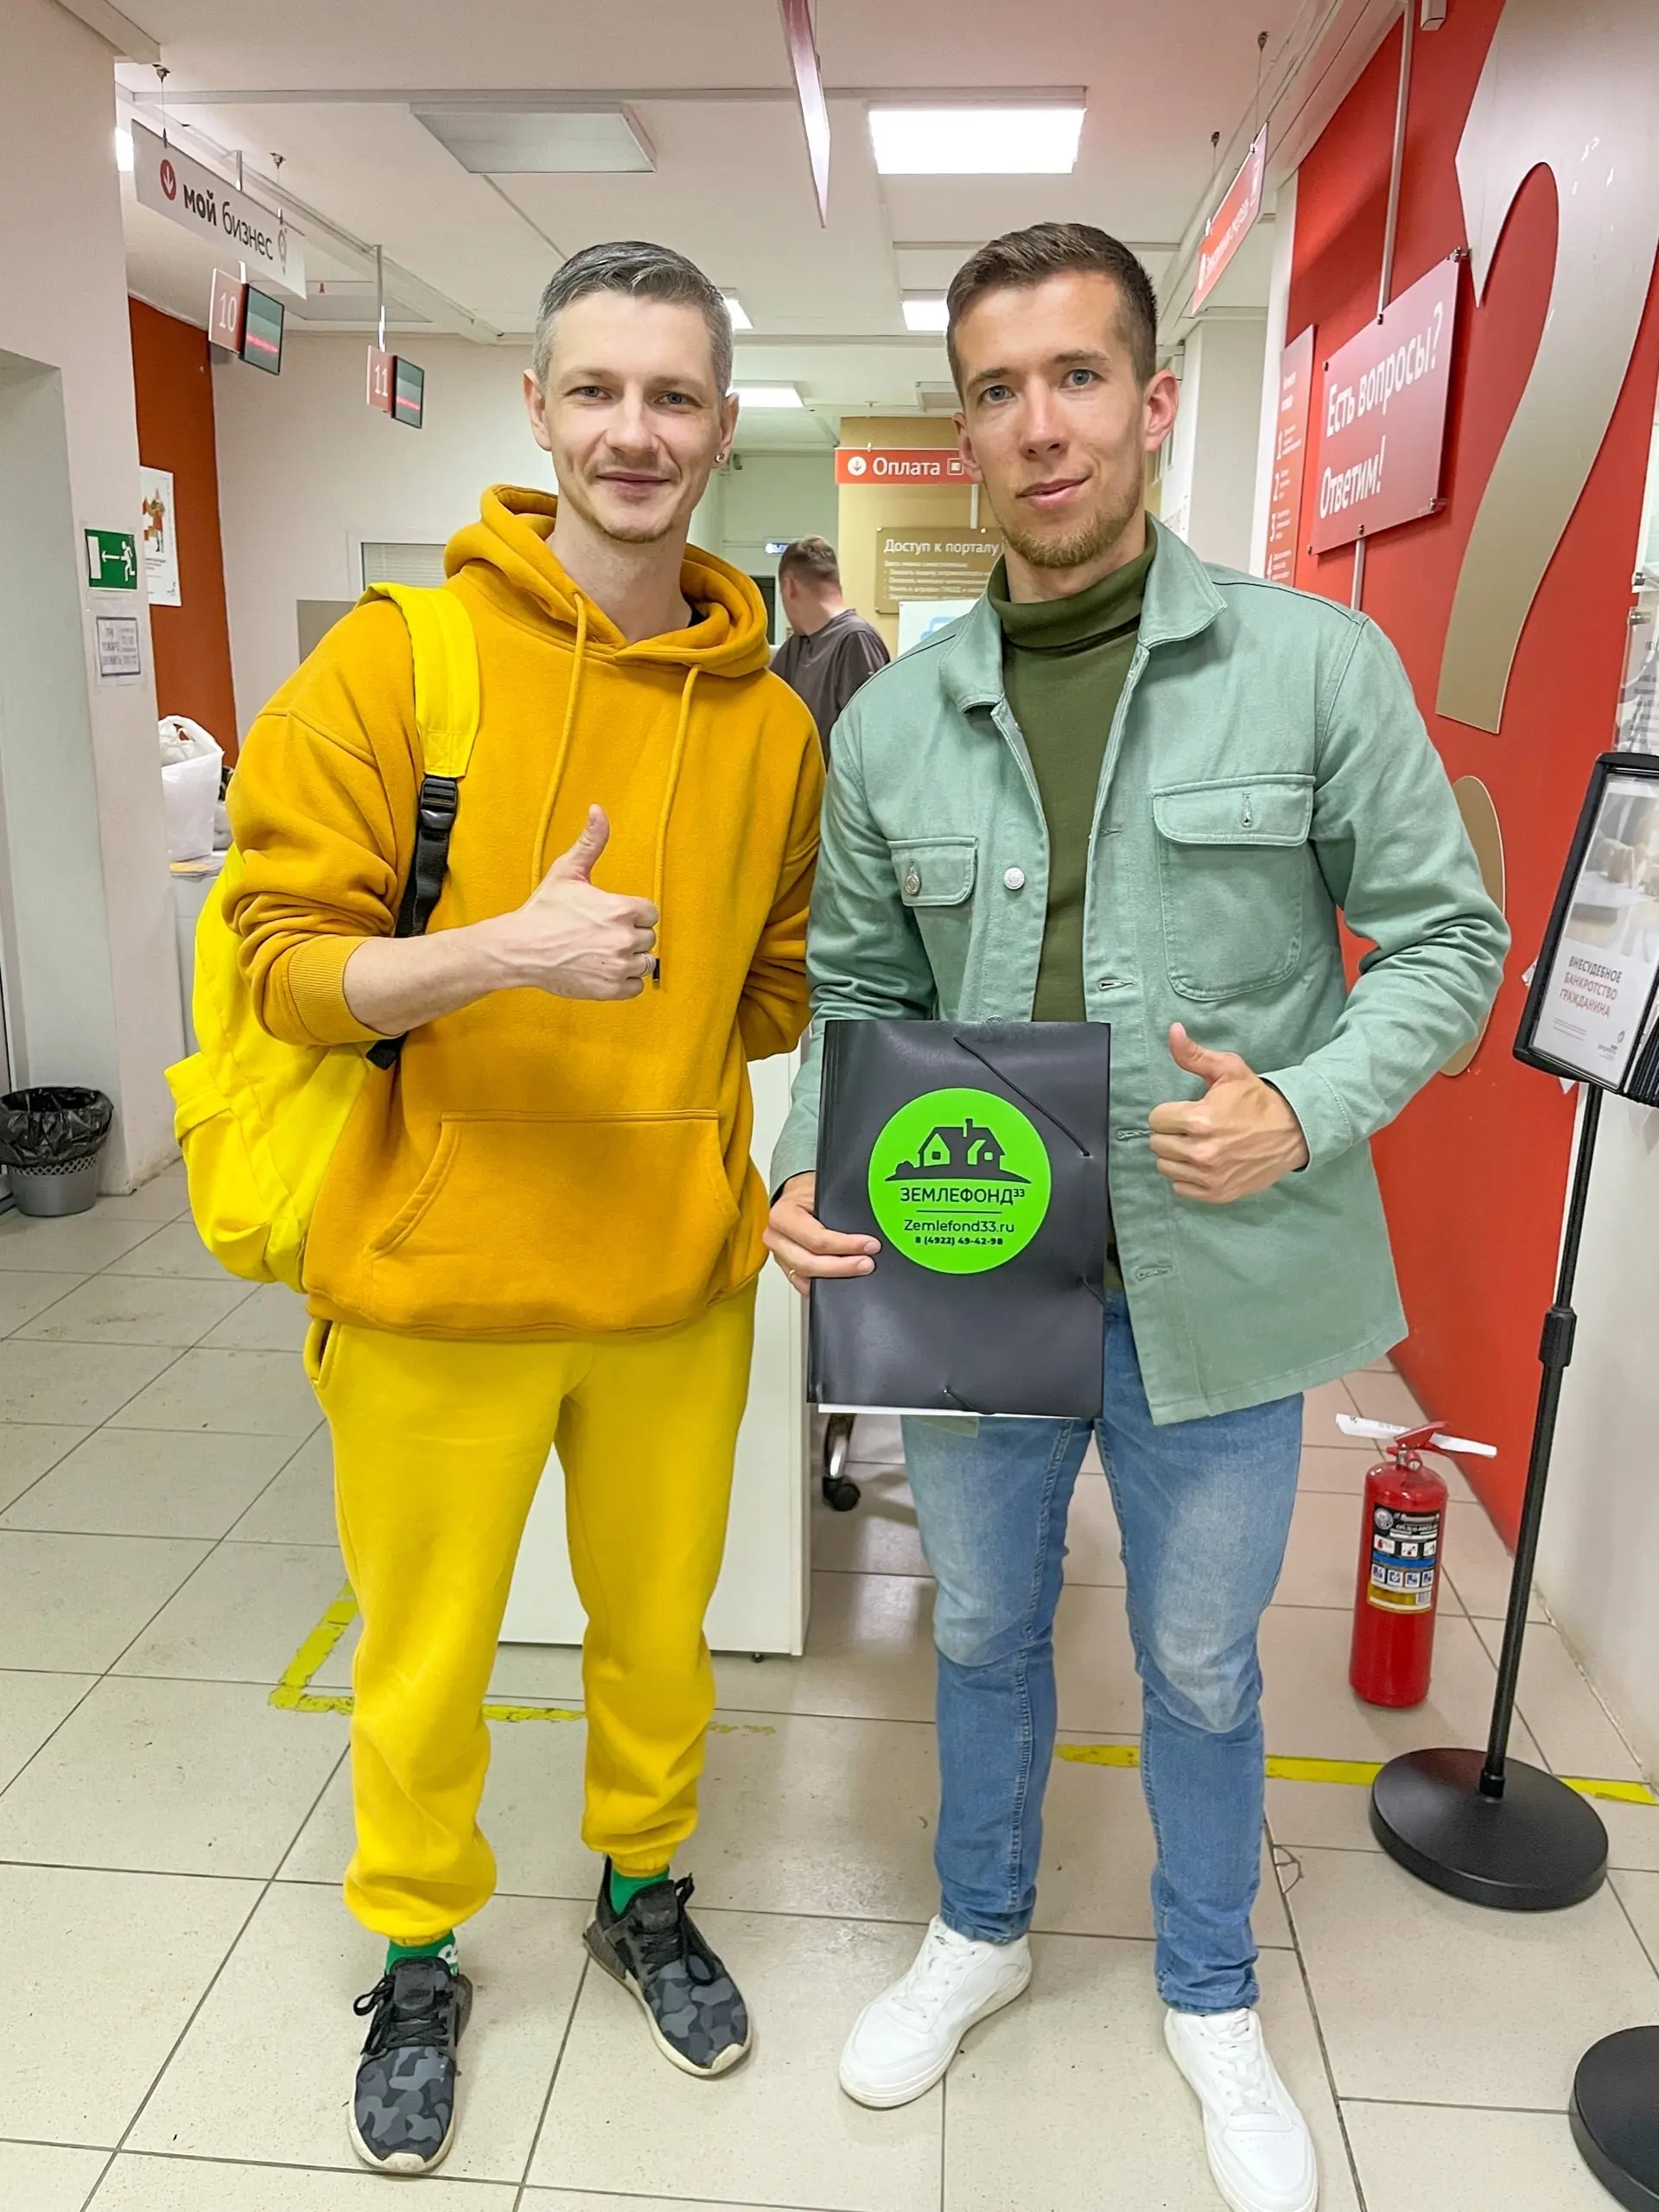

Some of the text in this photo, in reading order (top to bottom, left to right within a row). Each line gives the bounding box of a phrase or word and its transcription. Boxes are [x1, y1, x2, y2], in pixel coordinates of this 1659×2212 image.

[183, 184, 273, 260] мой бизнес
[219, 292, 237, 332] 10
[374, 364, 389, 397] 11
[1326, 301, 1443, 437] Есть вопросы?
[872, 457, 941, 476] Оплата
[1319, 435, 1386, 519] Ответим!
[883, 538, 1000, 556] Доступ к порталу
[1568, 956, 1623, 983] ВНЕСУДЕБНОЕ
[1564, 972, 1618, 1001] БАНКРОТСТВО
[1560, 988, 1611, 1018] ГРАЖДАНИНА
[904, 1219, 1014, 1233] Zemlefond33.ru
[924, 1236, 955, 1246] (4922)
